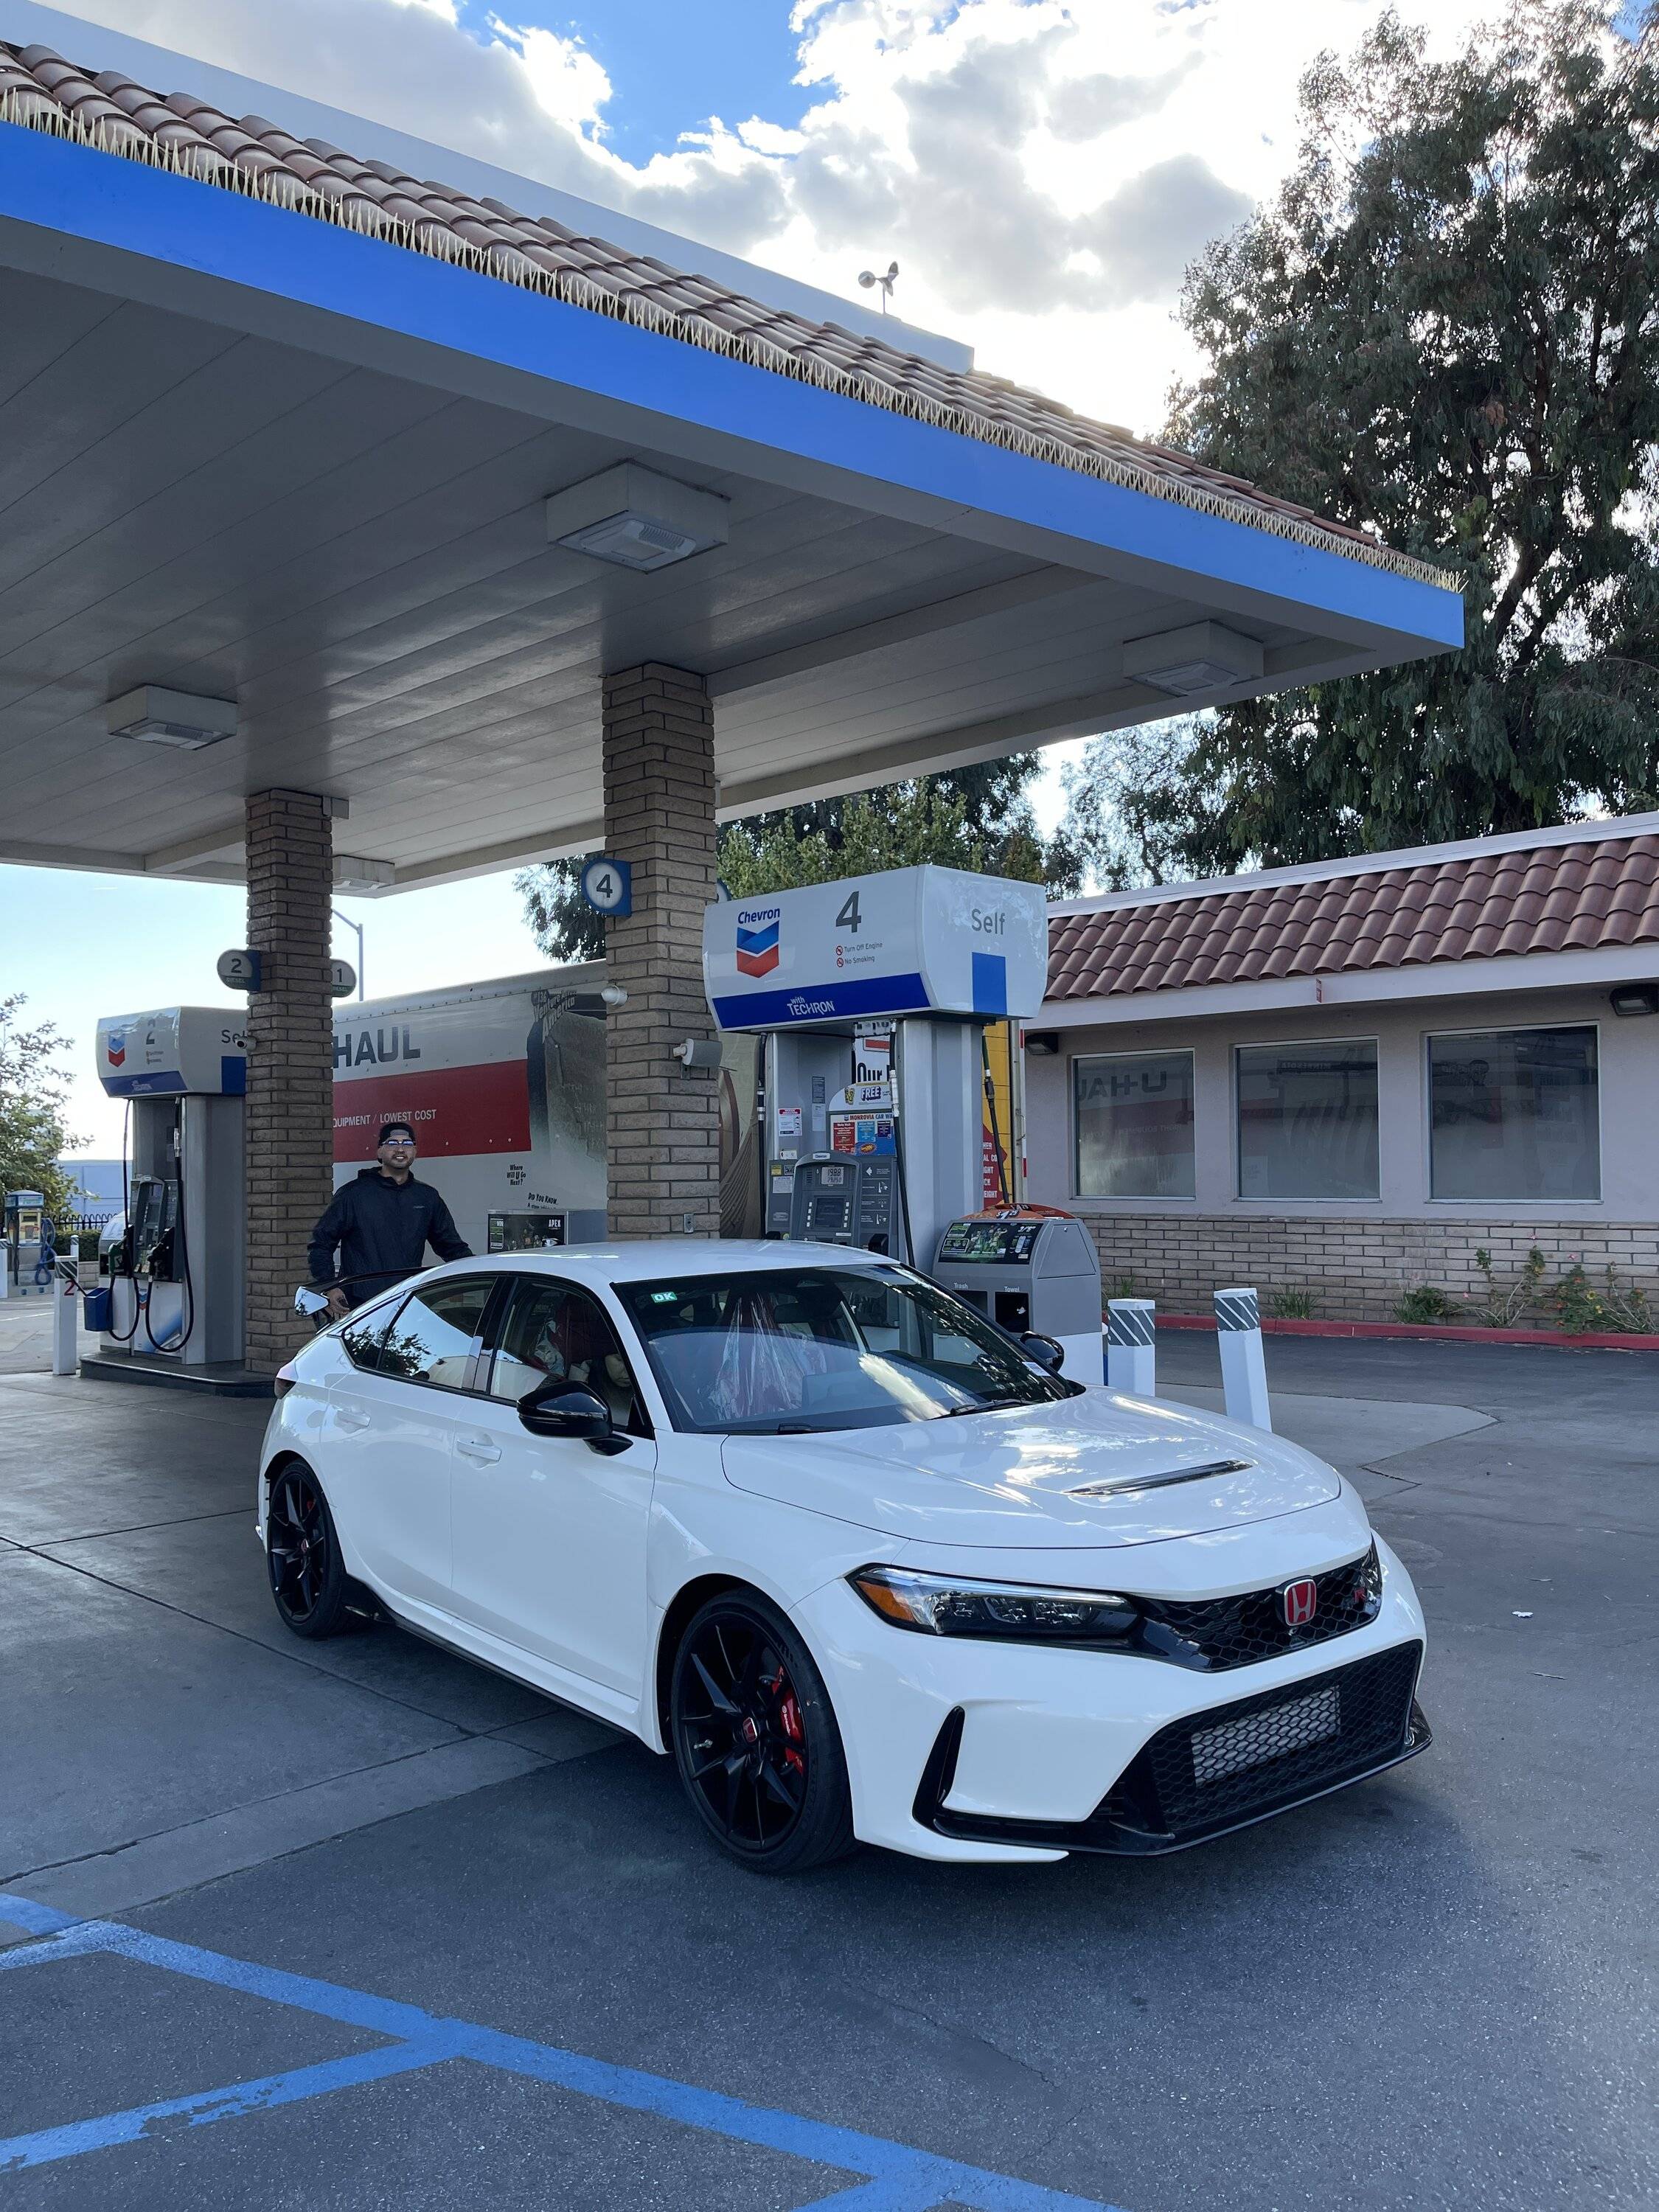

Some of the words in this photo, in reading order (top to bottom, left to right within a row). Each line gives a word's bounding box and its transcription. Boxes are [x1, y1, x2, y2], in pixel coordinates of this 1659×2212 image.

[596, 874, 613, 899] 4
[737, 908, 781, 925] Chevron
[835, 890, 862, 933] 4
[971, 908, 1006, 936] Self
[231, 958, 242, 974] 2
[336, 967, 343, 983] 1
[790, 996, 805, 1004] with
[787, 1001, 835, 1016] TECHRON
[861, 1086, 881, 1102] FREE
[380, 1111, 412, 1123] LOWEST
[414, 1109, 437, 1121] COST
[515, 1171, 519, 1180] U
[548, 1219, 561, 1227] APEX
[64, 1279, 75, 1296] 2
[654, 1293, 675, 1301] OK
